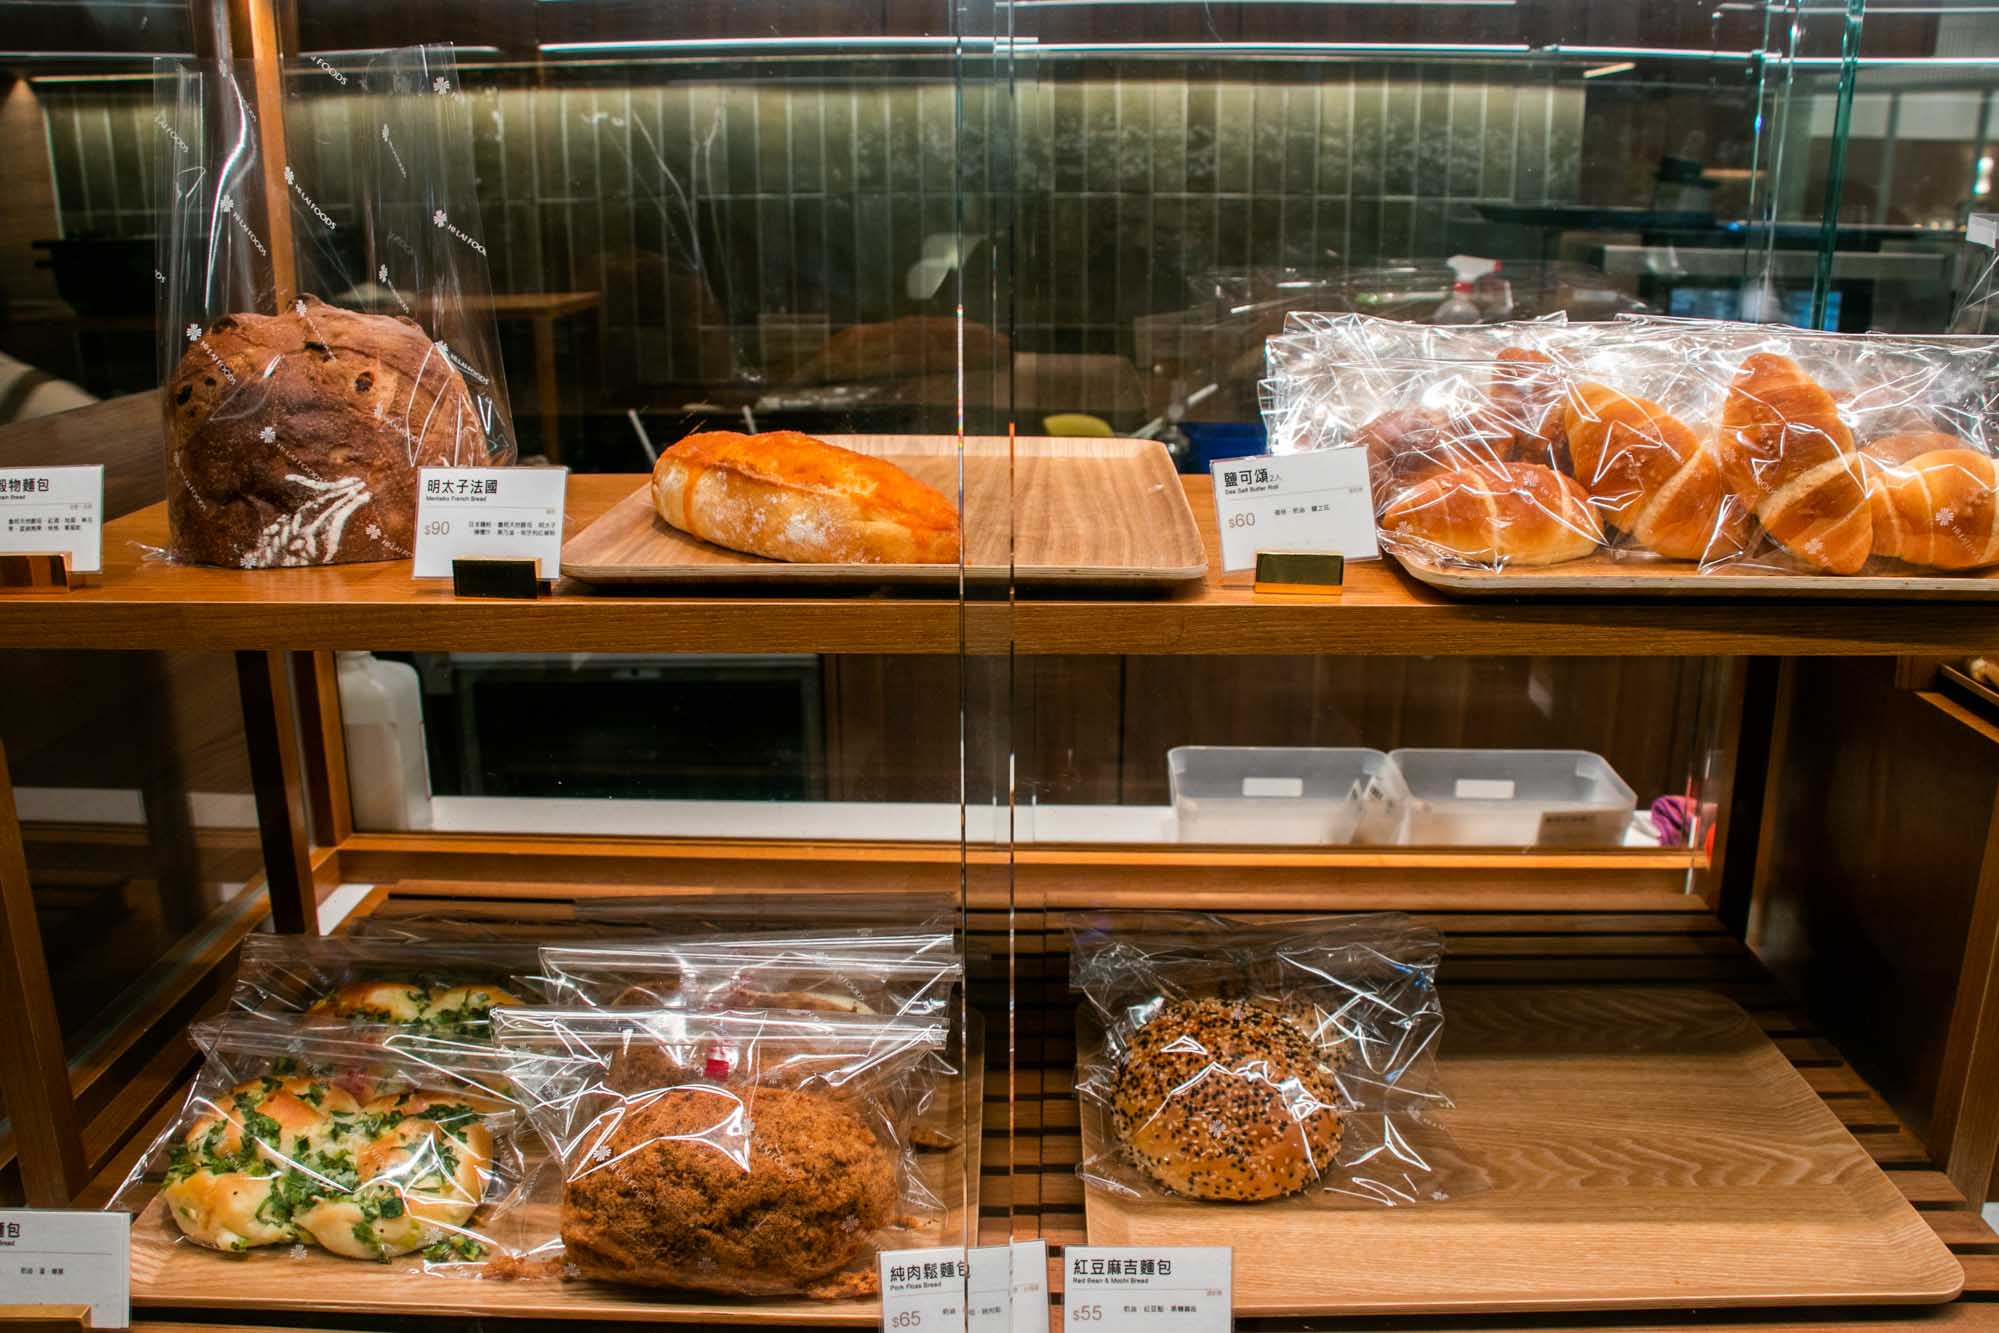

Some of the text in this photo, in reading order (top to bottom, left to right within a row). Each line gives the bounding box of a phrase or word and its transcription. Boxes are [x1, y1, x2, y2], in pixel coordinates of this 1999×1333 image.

[1224, 468, 1269, 487] 鹽可頌
[427, 479, 498, 494] 明太子法國
[424, 521, 451, 536] $90
[1228, 512, 1256, 528] $60
[1074, 1259, 1172, 1276] 紅豆麻吉麵包
[891, 1310, 921, 1328] $65
[1073, 1304, 1104, 1321] $55
